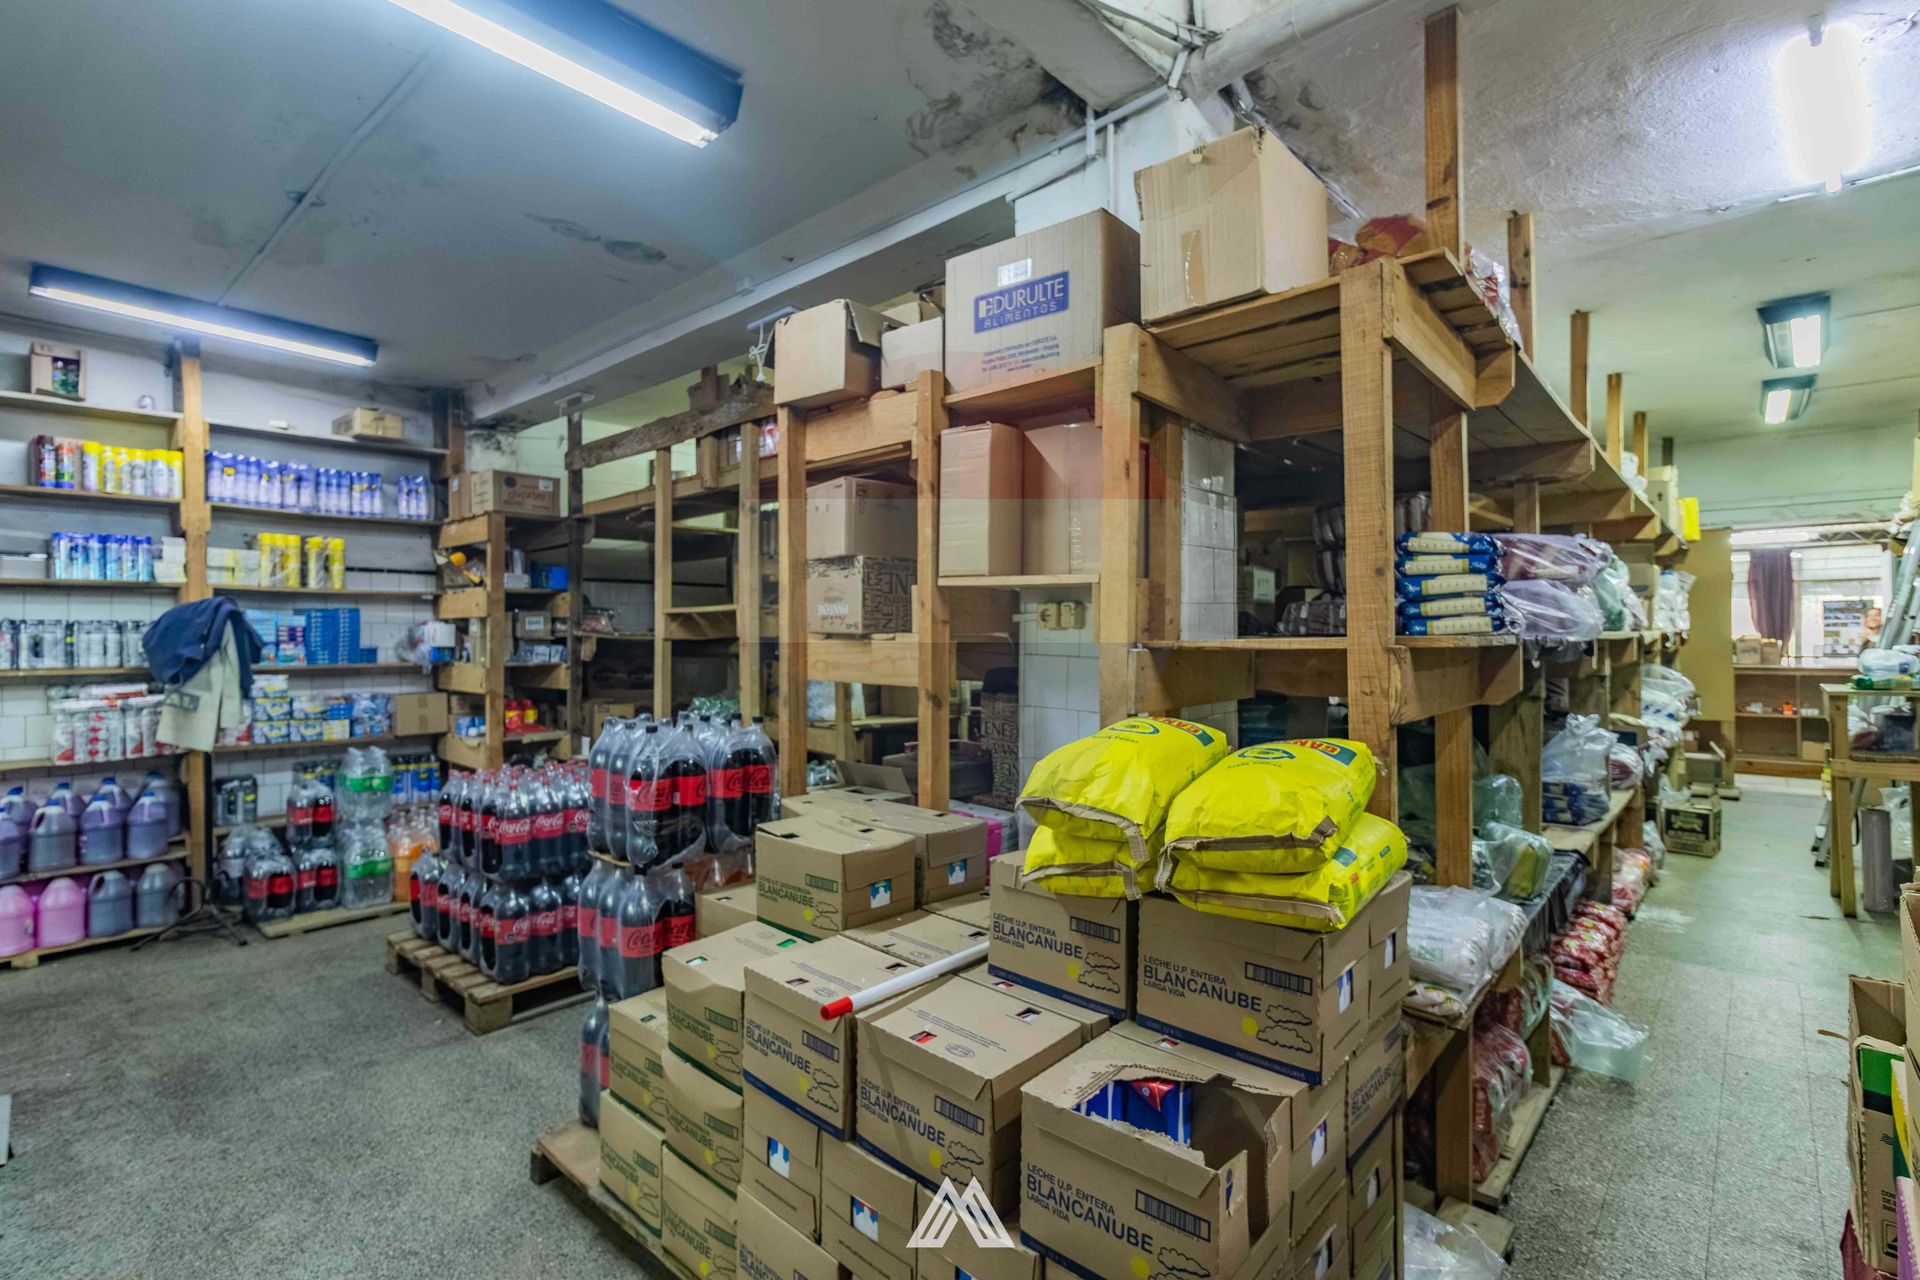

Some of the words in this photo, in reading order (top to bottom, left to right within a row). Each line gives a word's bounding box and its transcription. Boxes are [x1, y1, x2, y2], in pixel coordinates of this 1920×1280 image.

[993, 920, 1083, 959] BLANCANUBE
[1028, 923, 1056, 937] ENTERA
[1143, 954, 1171, 971] LECHE
[1190, 968, 1227, 986] ENTERA
[1143, 978, 1167, 993] LARGA
[1168, 987, 1186, 998] VIDA
[1143, 964, 1262, 1013] BLANCANUBE
[746, 1026, 812, 1075] BLANCANUBE
[860, 1086, 946, 1148] BLANCANUBE
[1026, 1190, 1050, 1211] LARGA
[1052, 1205, 1070, 1224] VIDA
[1027, 1161, 1056, 1185] LECHE
[1076, 1188, 1115, 1216] ENTERA
[1027, 1173, 1153, 1255] BLANCANUBE
